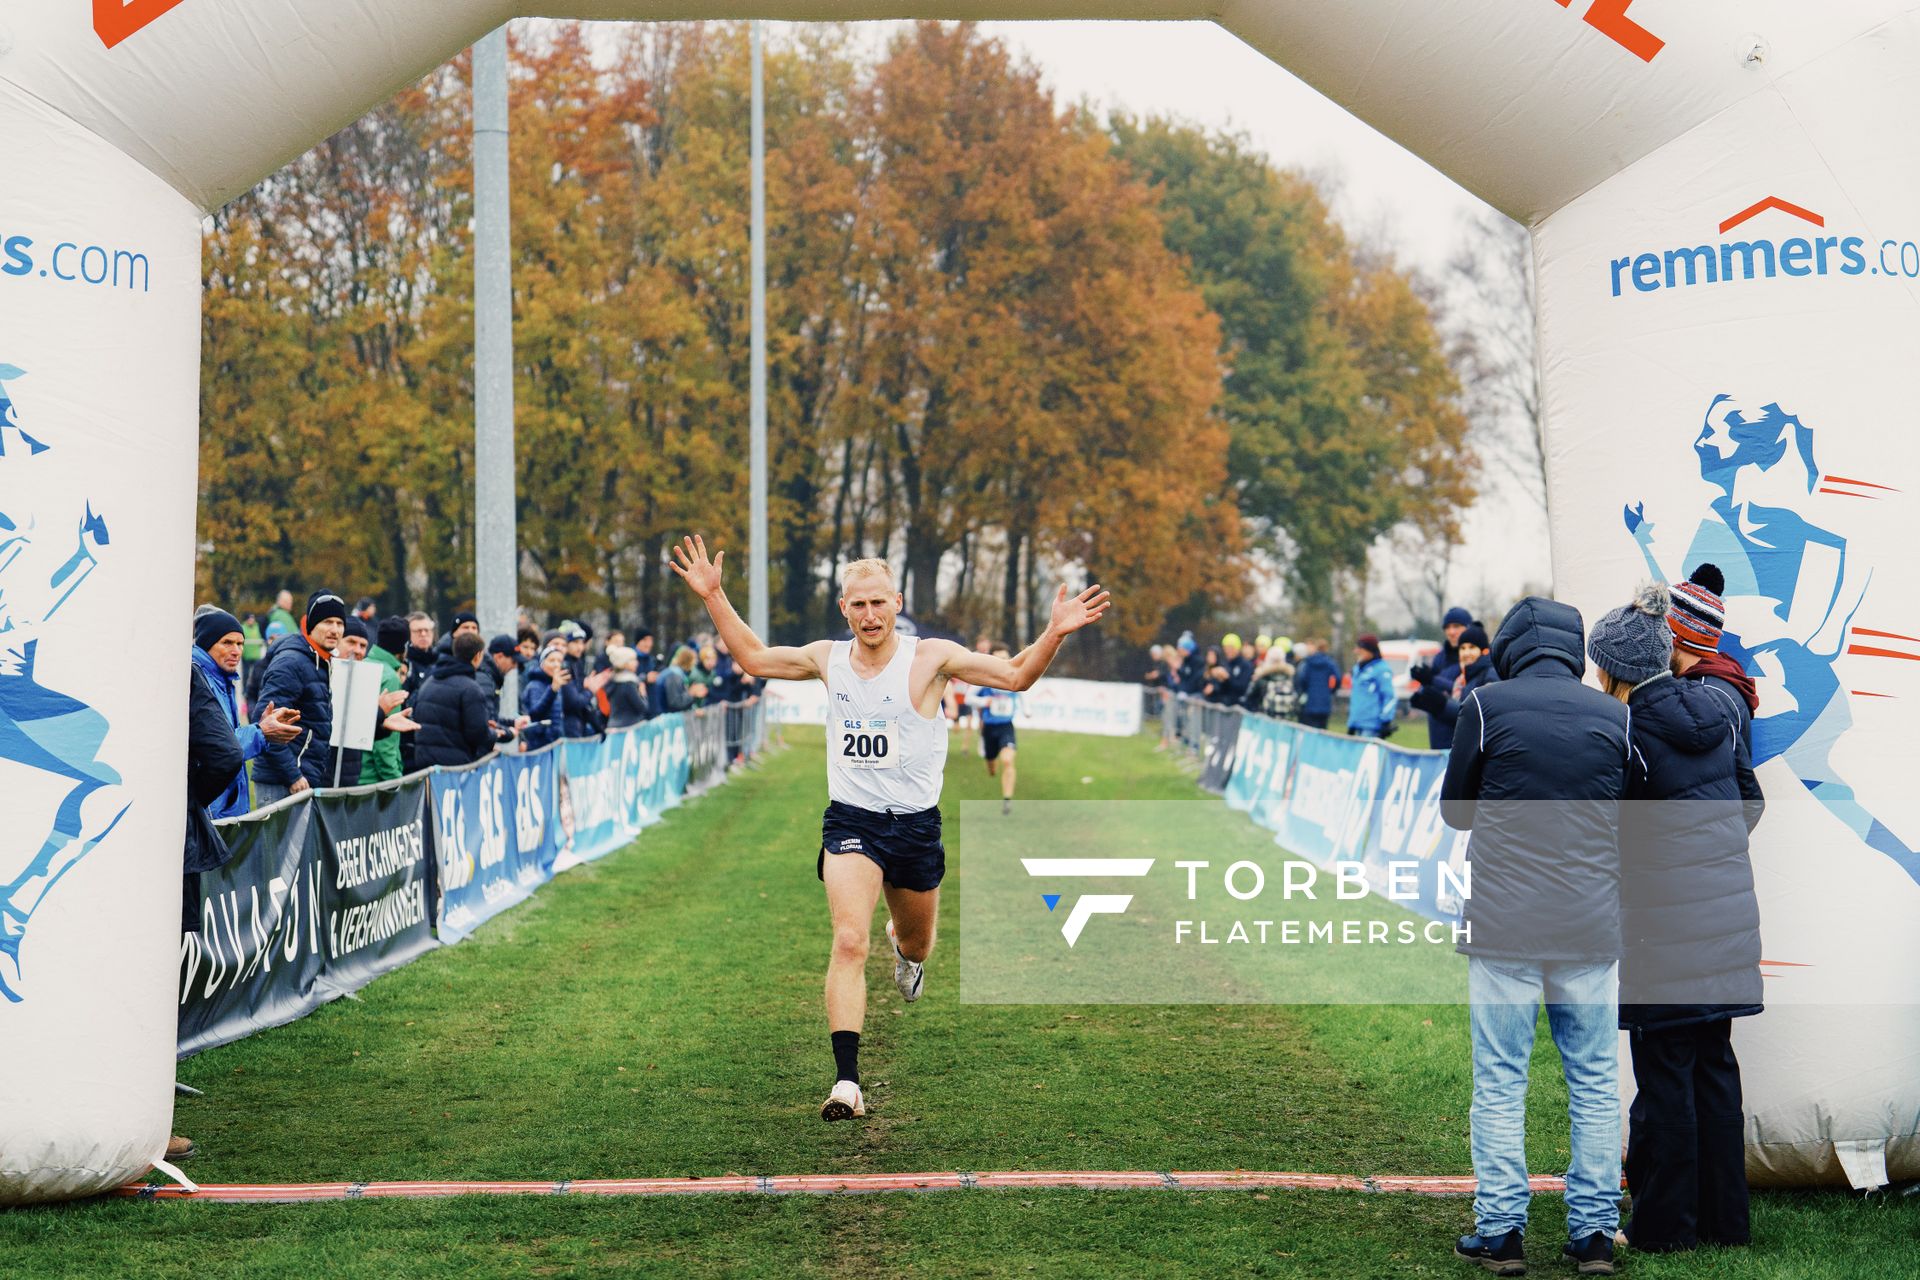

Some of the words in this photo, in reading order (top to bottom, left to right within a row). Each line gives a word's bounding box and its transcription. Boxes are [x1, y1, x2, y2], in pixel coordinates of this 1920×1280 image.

[0, 234, 149, 292] s.com
[837, 692, 850, 703] TVL
[843, 733, 888, 758] 200
